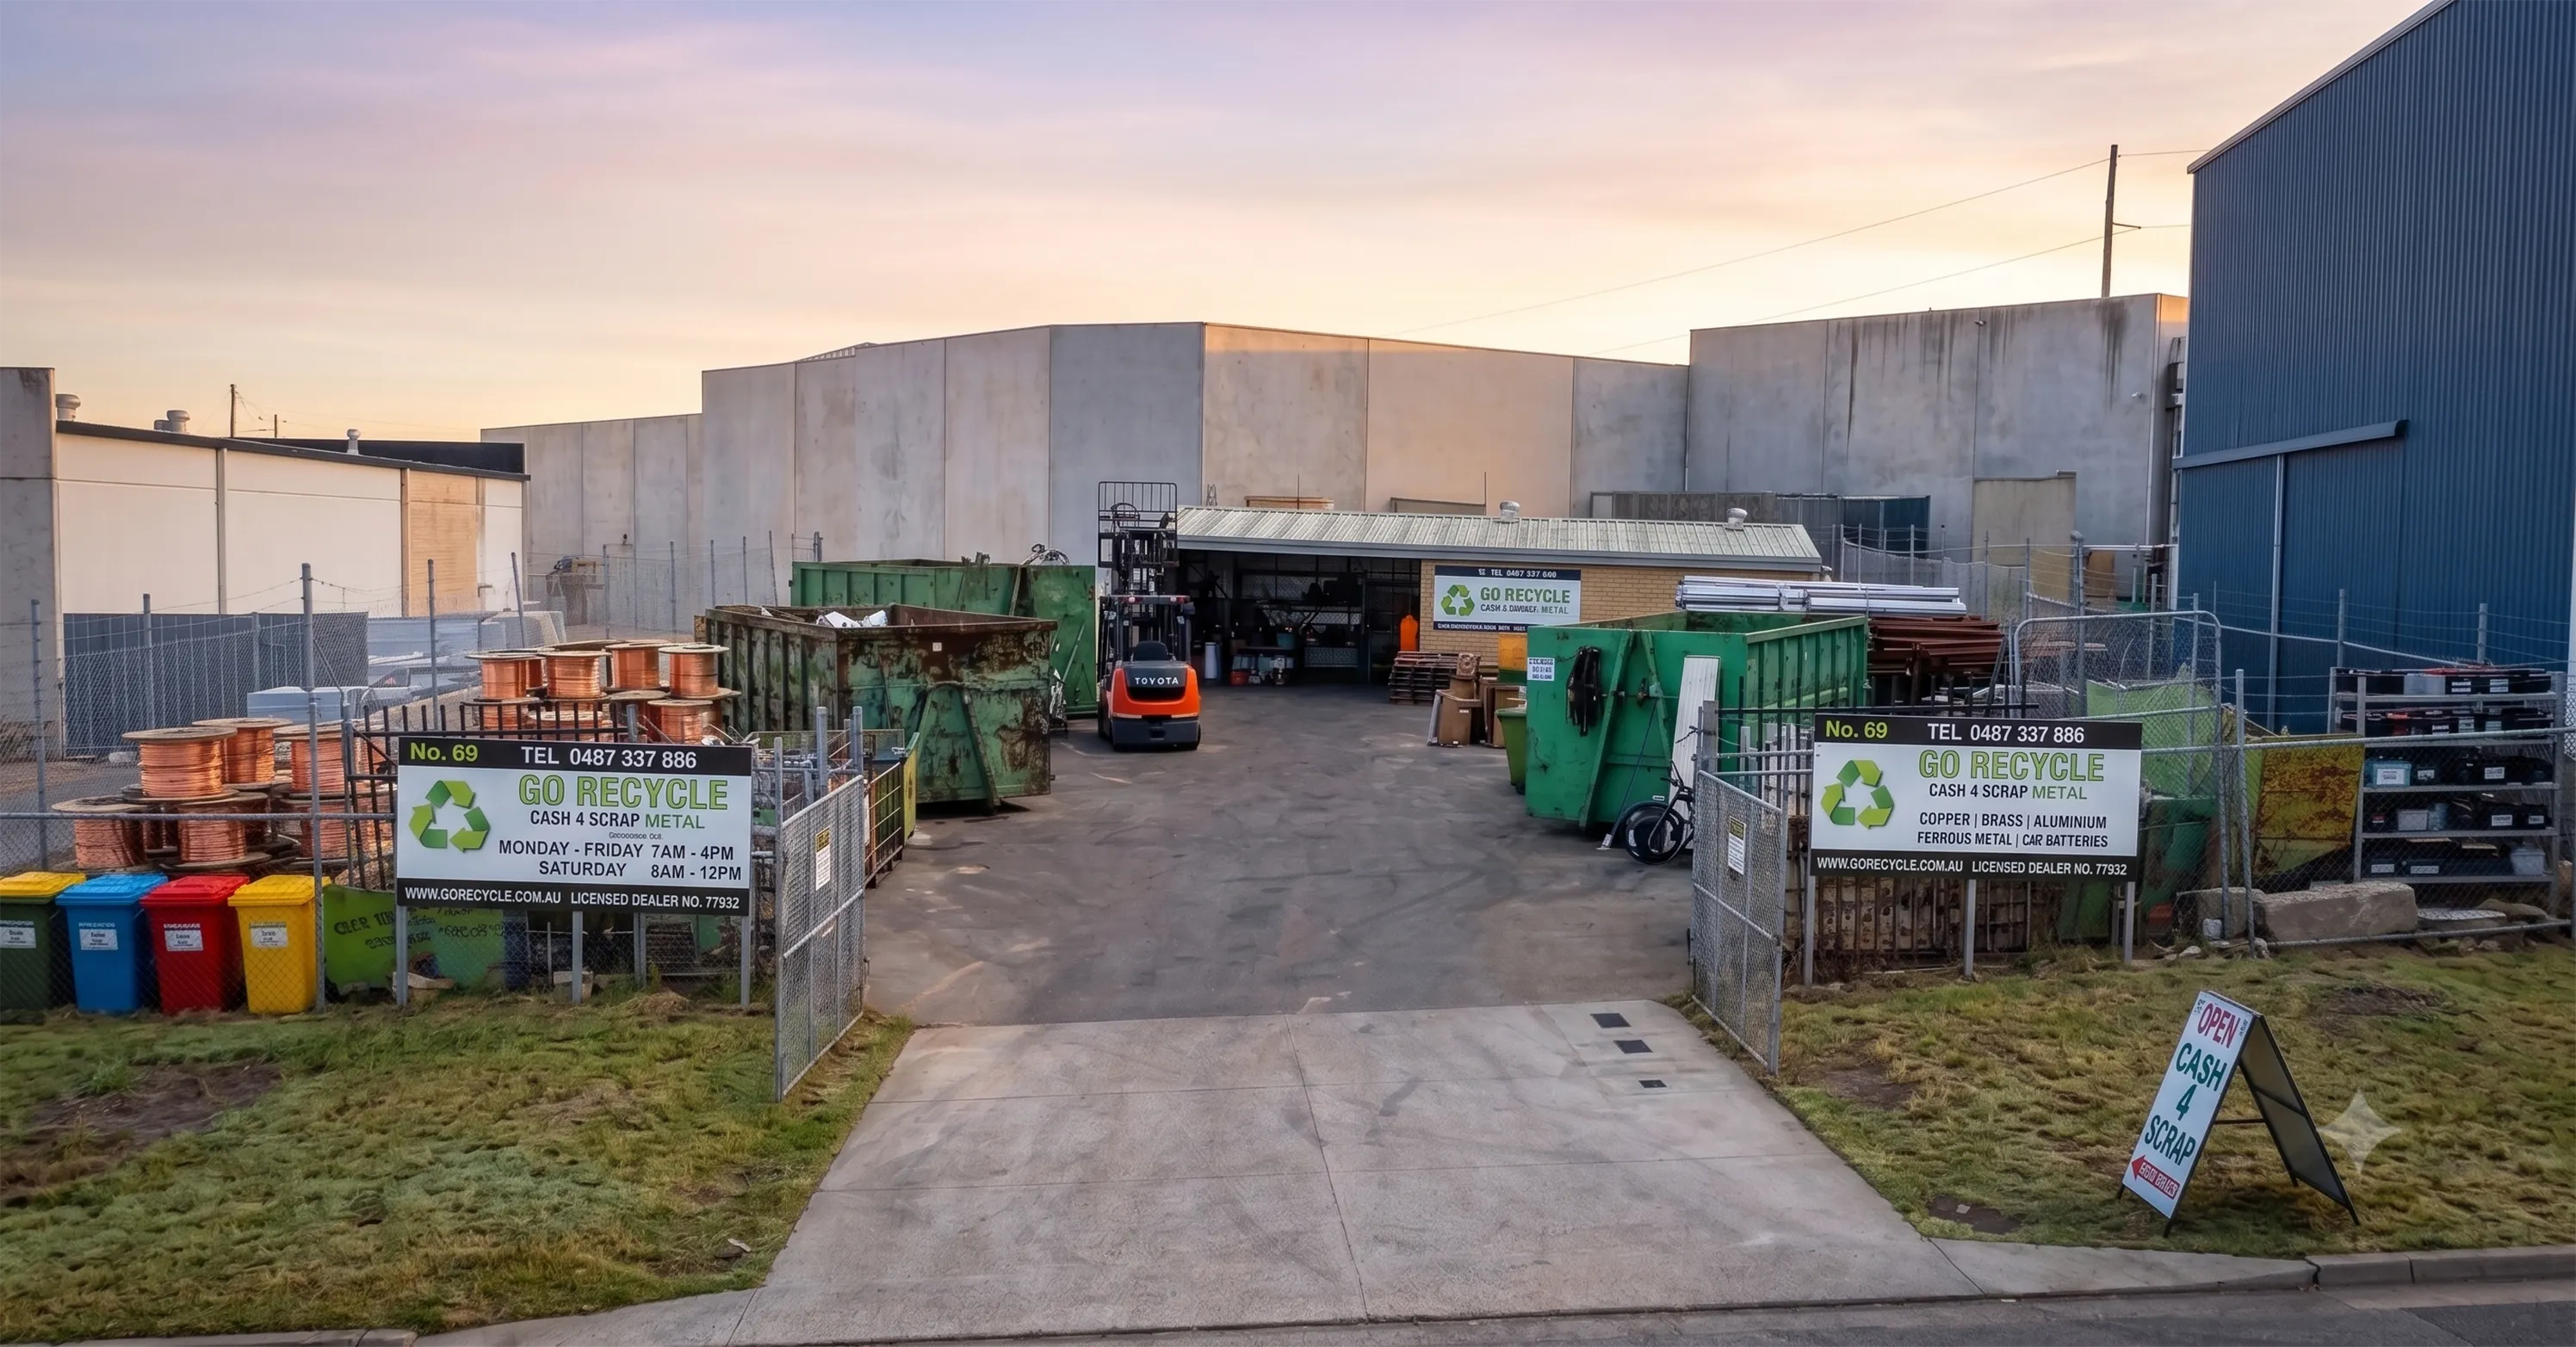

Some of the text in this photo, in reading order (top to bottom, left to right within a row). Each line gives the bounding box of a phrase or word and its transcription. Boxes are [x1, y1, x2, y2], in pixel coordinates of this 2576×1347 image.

[1481, 587, 1570, 603] GO RECYCLE
[1541, 606, 1569, 614] METAL
[1135, 677, 1179, 685] TOYOTA
[1825, 720, 1887, 738] No. 69
[1928, 723, 2085, 744] TEL 0487 337 886
[410, 742, 478, 762] No. 69
[521, 746, 697, 769] TEL 0487 337 886
[1919, 750, 2105, 782] GO RECYCLE
[519, 774, 728, 810] GO RECYCLE
[1929, 783, 2087, 800] CASH 4 SCRAP METAL
[530, 809, 705, 829] CASH 4 SCRAP METAL
[1919, 812, 1970, 827] COPPER
[1981, 813, 2023, 828] BRASS
[2034, 814, 2107, 829] ALUMINIUM
[499, 840, 570, 856] MONDAY
[585, 842, 644, 858] FRIDAY
[651, 844, 685, 859] 7AM
[700, 846, 734, 860] 4PM
[1917, 832, 1972, 846] FERROUS
[1975, 833, 2012, 846] METAL
[2022, 834, 2043, 847] CAR
[2046, 834, 2108, 848] BATTERIES
[539, 861, 627, 877] SATURDAY
[651, 864, 685, 879] 8AM
[700, 865, 742, 880] 12PM
[1817, 857, 2127, 876] WWW.GORECYCLE.COM.AU LICENSED DEALER NO. 77932
[405, 886, 740, 910] WWW.GORECYCLE.COM.AU LICENSED DEALER NO. 77932
[2198, 1003, 2241, 1048] OPEN
[2176, 1043, 2227, 1091] CASH
[2176, 1084, 2197, 1121] 4
[2144, 1115, 2196, 1166] SCRAP
